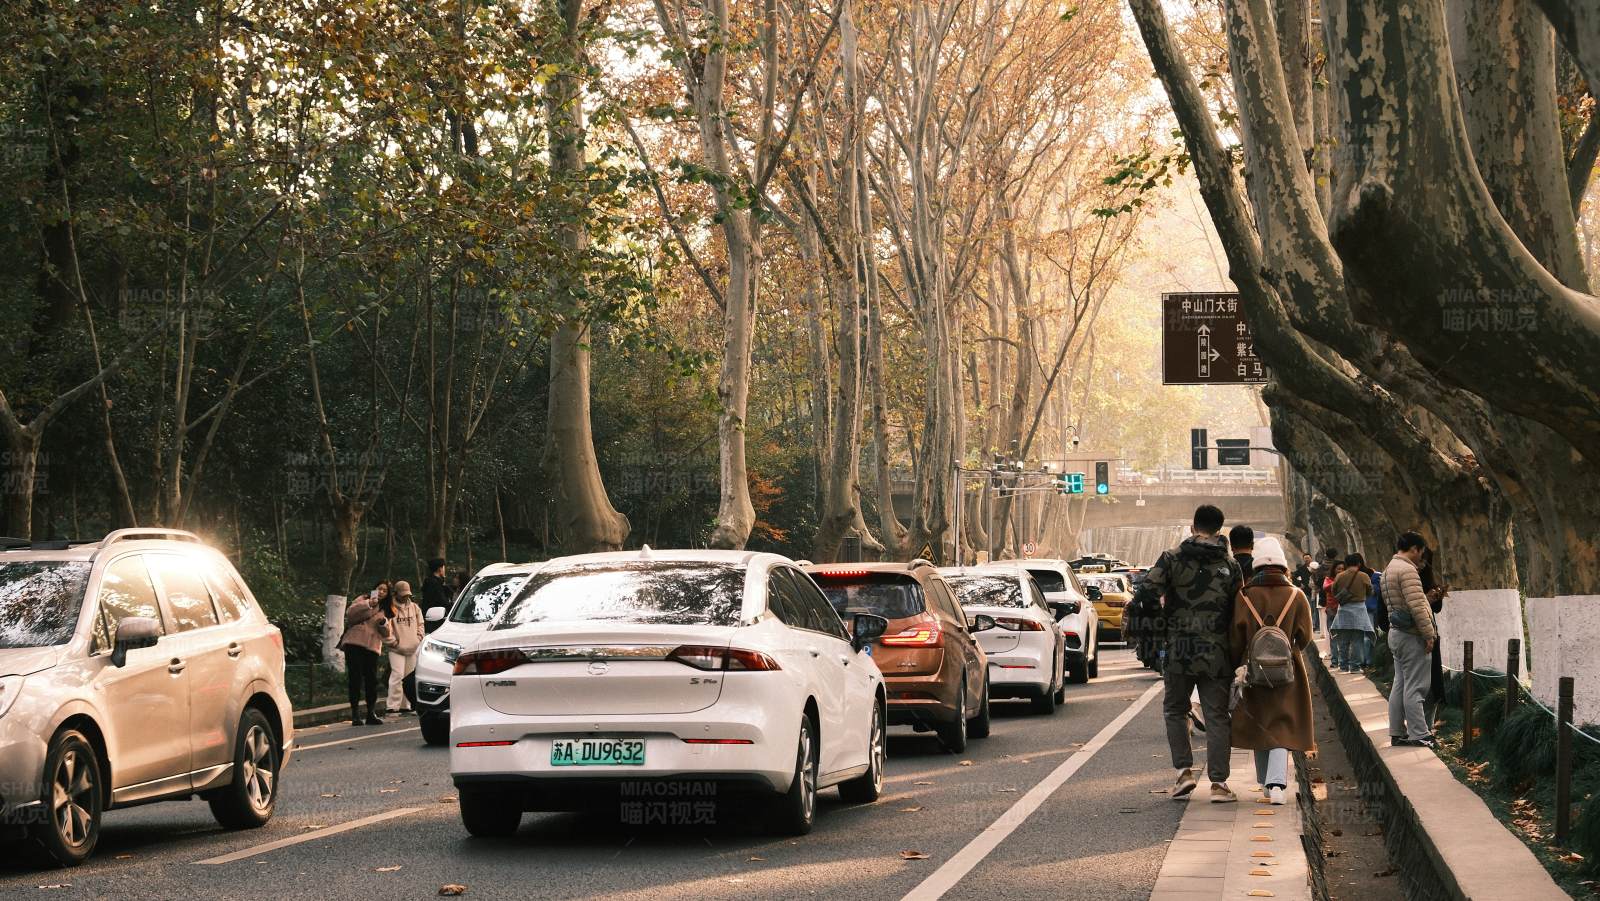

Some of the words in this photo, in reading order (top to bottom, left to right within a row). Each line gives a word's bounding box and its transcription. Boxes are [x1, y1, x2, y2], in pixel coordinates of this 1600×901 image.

[1182, 298, 1237, 313] 中山门大街
[1237, 362, 1262, 376] 白马
[554, 742, 573, 760] 苏A
[582, 742, 643, 760] DU9632
